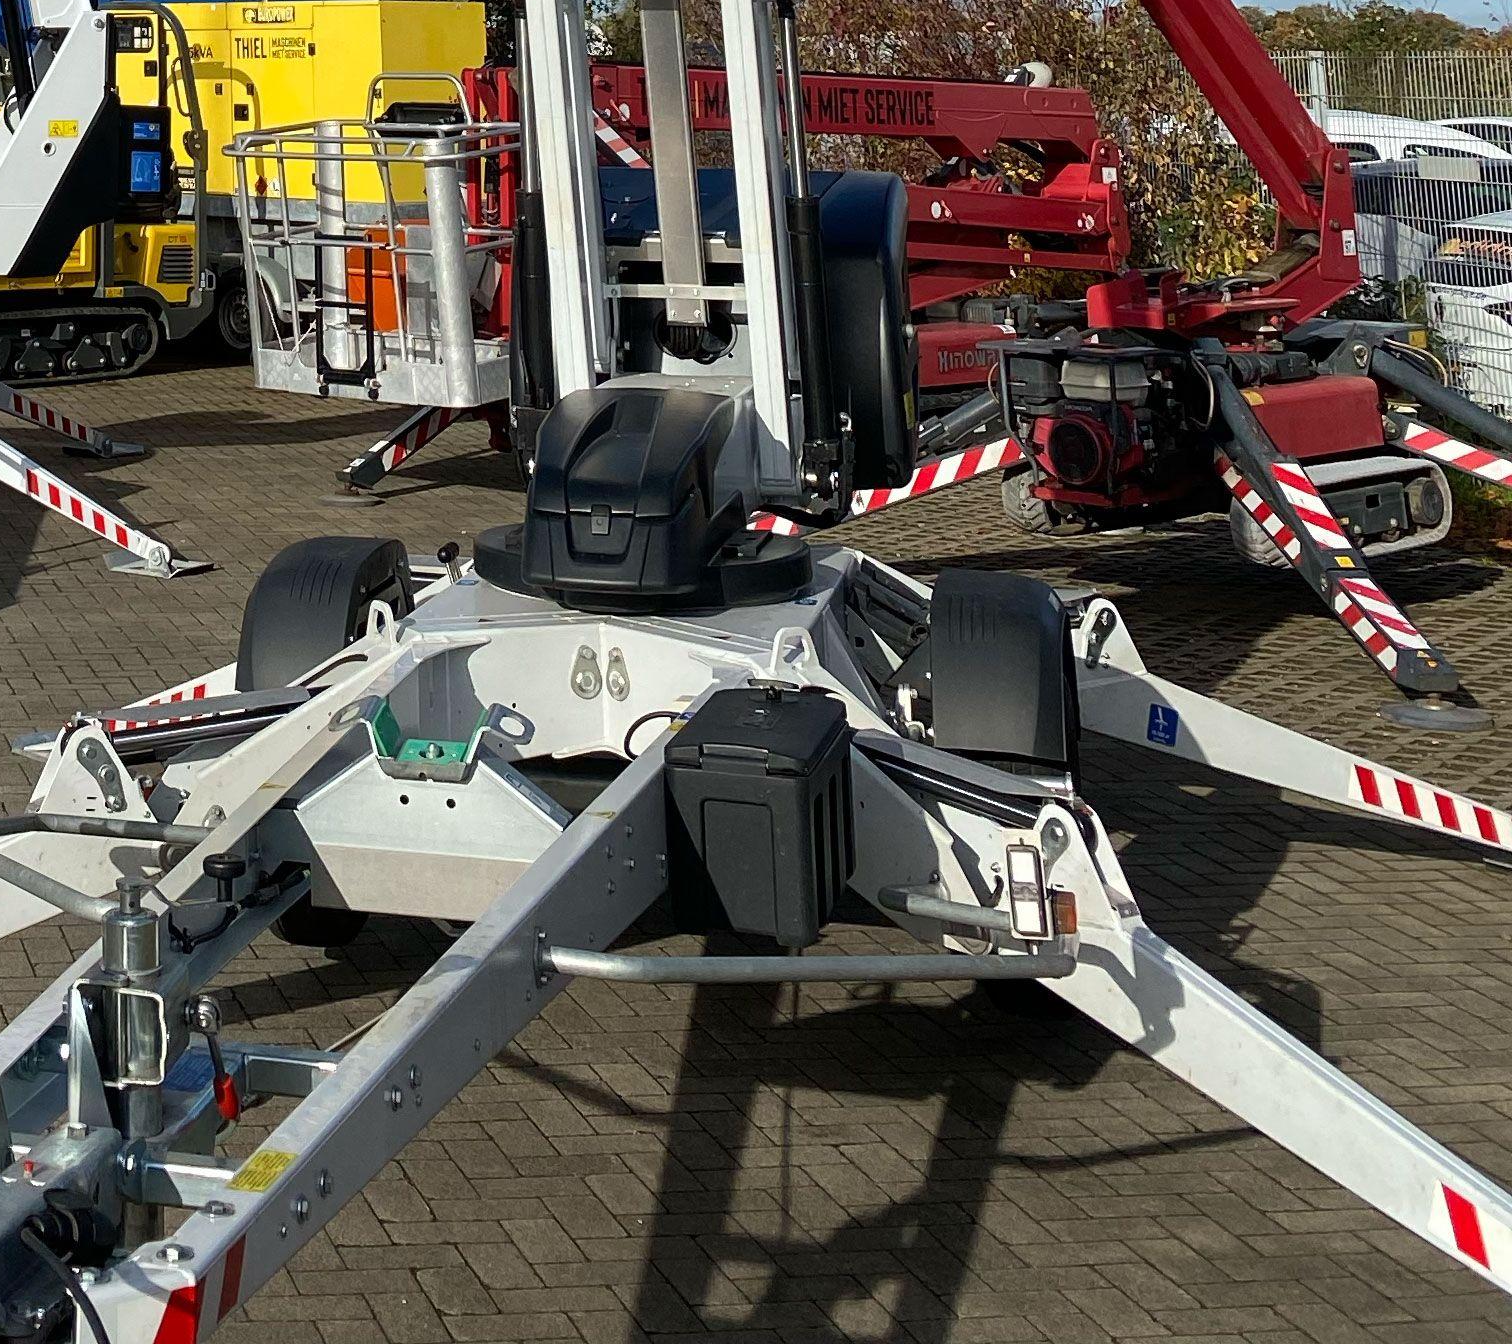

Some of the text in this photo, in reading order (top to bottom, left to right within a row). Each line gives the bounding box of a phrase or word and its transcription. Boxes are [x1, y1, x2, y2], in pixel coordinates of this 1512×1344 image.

[234, 37, 267, 59] THIEL
[816, 86, 859, 124] MIET
[864, 88, 935, 127] SERVICE
